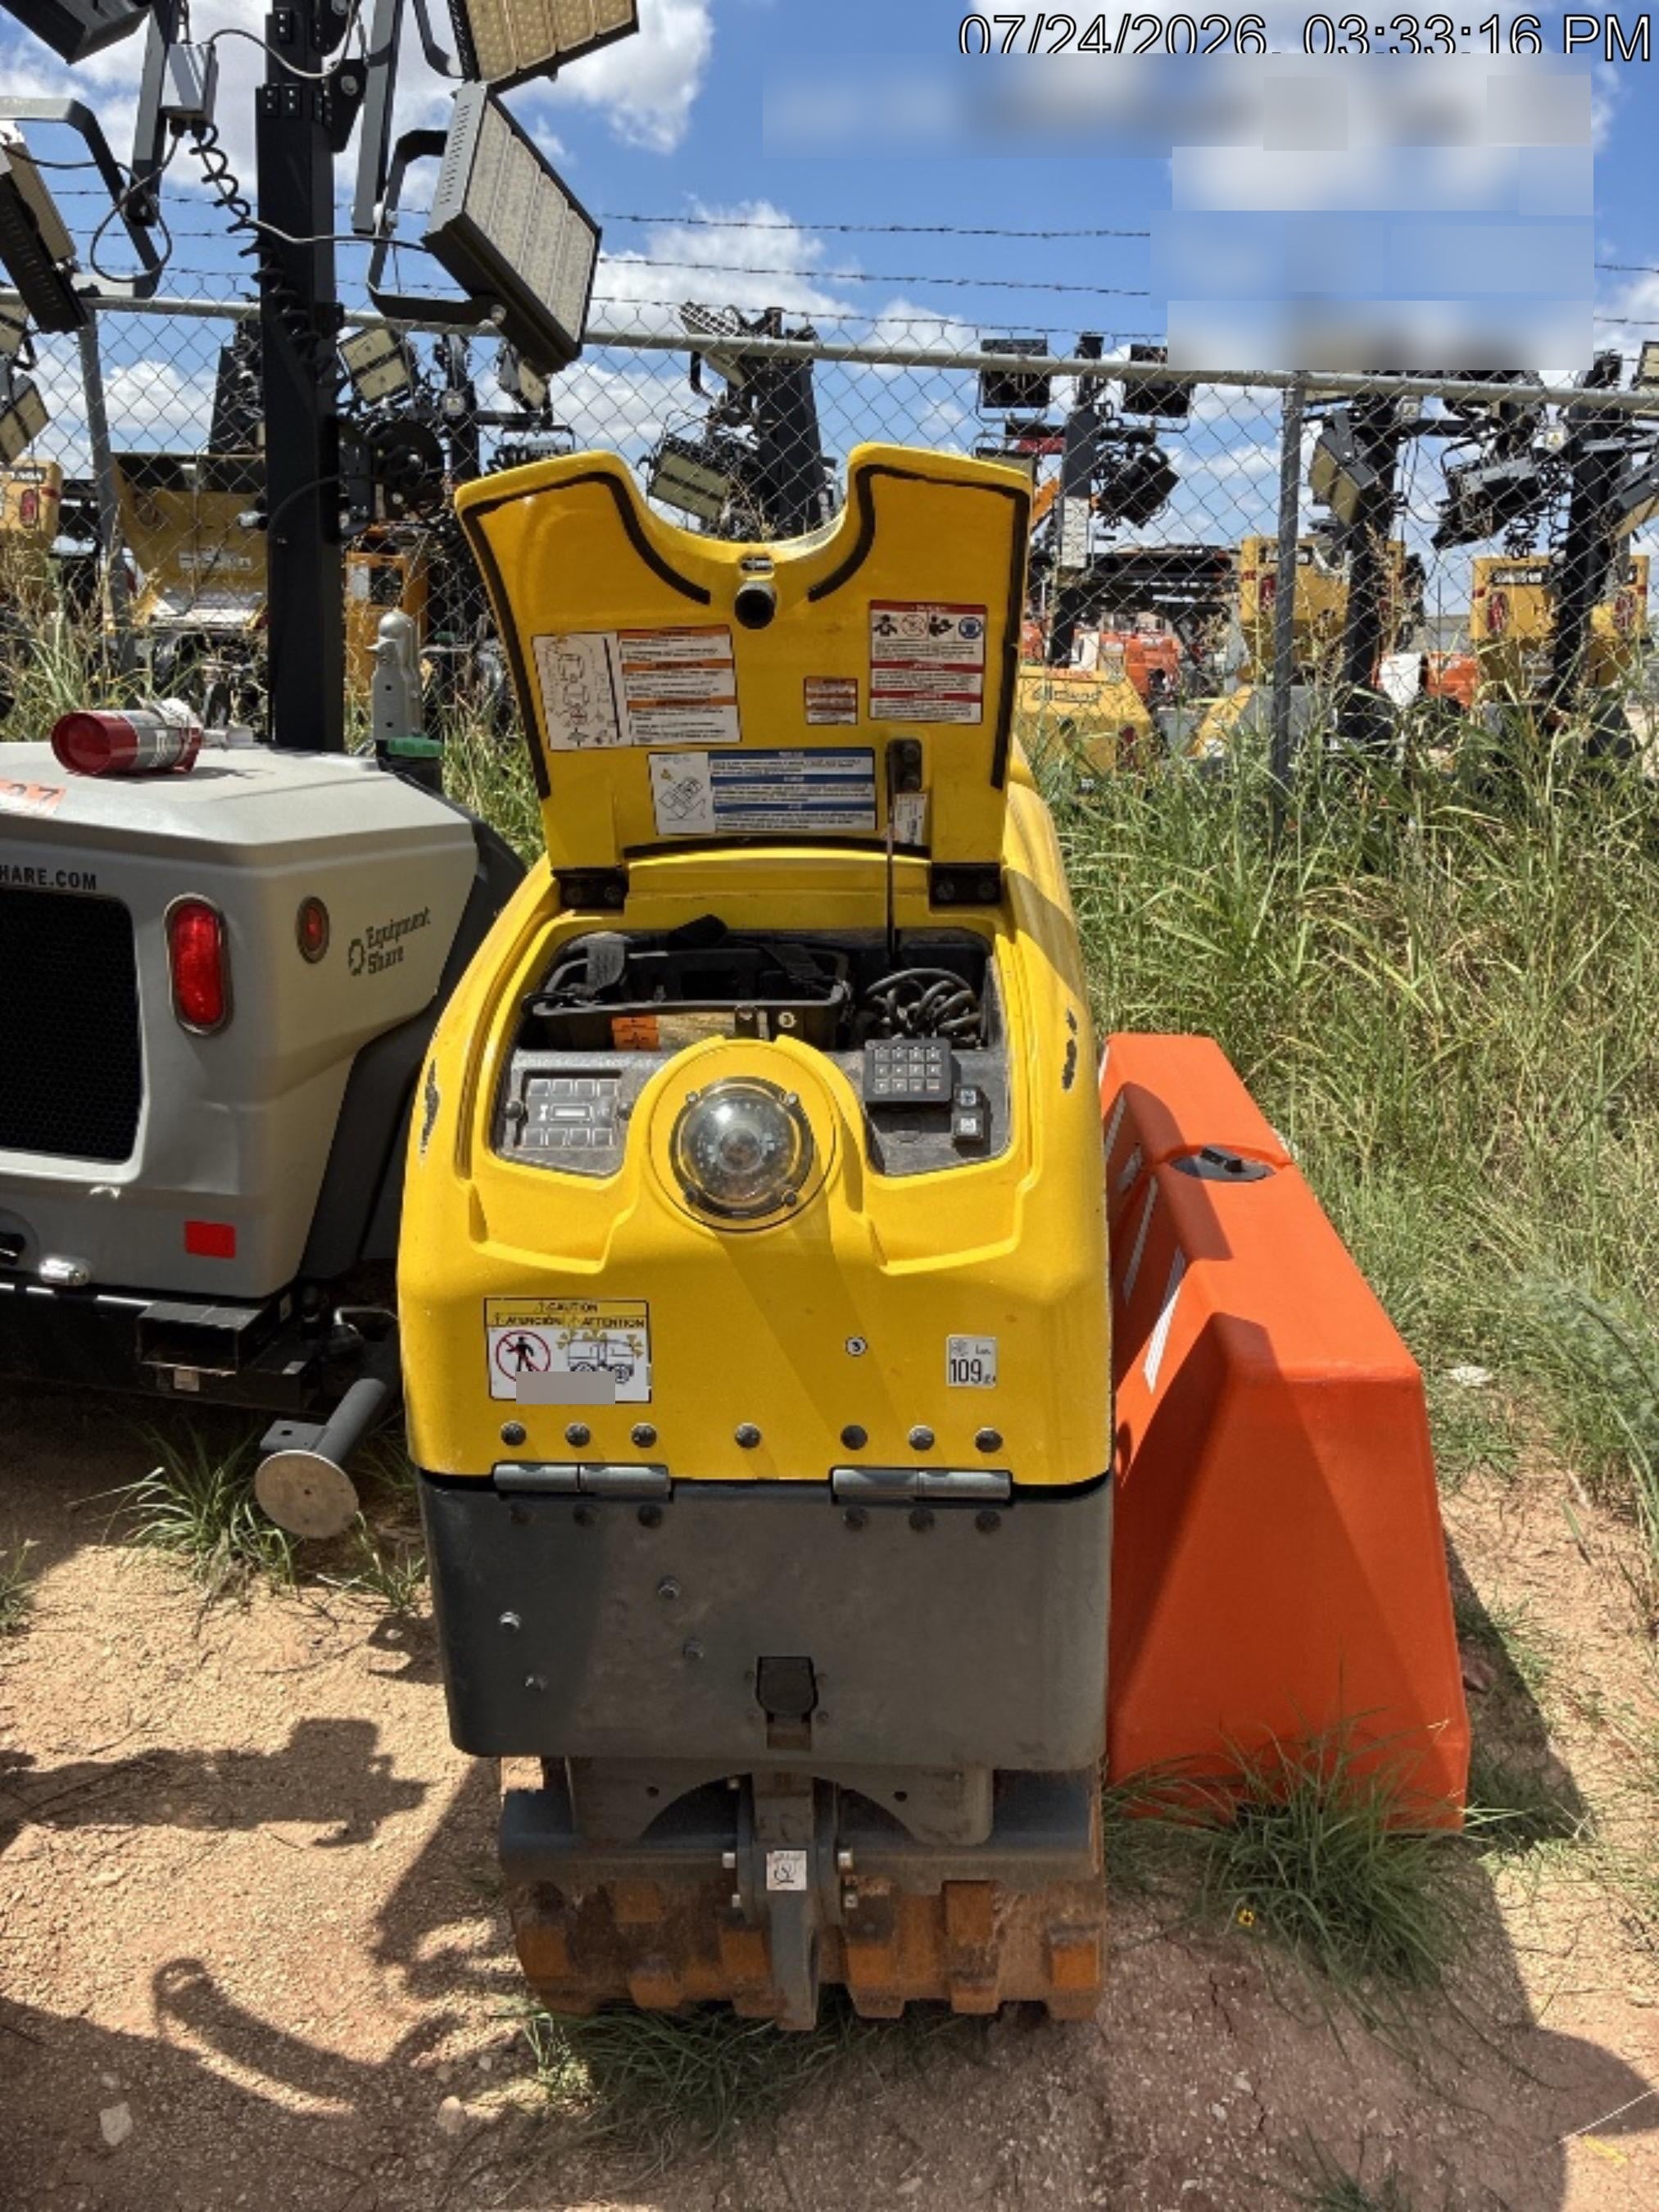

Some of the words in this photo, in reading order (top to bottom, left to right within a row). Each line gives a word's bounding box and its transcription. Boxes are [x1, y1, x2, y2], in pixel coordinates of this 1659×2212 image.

[365, 905, 431, 950] Equipment
[367, 945, 404, 974] Share
[546, 1302, 598, 1312] CAUTION
[582, 1317, 645, 1328] ATTENTION
[950, 1358, 981, 1384] 109
